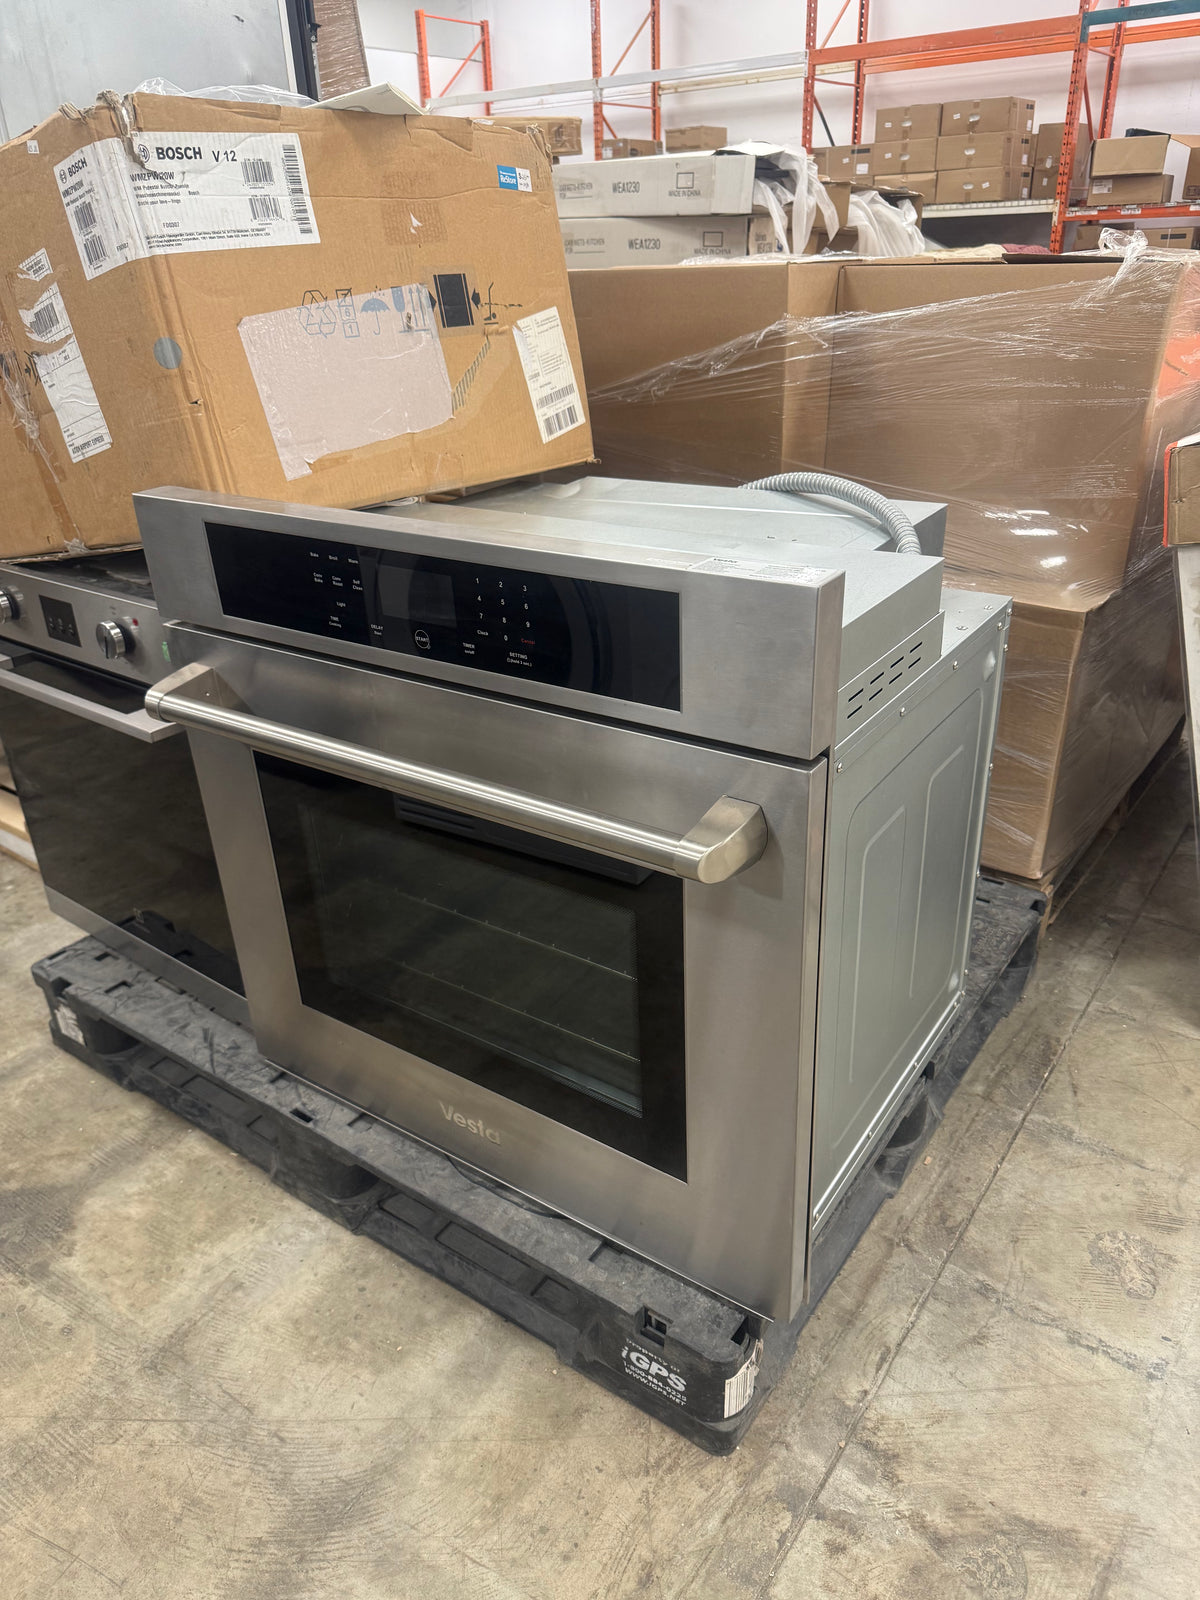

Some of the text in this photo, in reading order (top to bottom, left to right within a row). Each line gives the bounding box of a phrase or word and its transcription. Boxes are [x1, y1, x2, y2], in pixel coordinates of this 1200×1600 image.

[156, 146, 238, 162] BOSCH V 12
[68, 157, 88, 177] BOSCH
[612, 181, 640, 194] WEA1230
[628, 238, 661, 250] WEA1230
[440, 1100, 500, 1145] Vesta
[621, 1346, 687, 1392] iGPS
